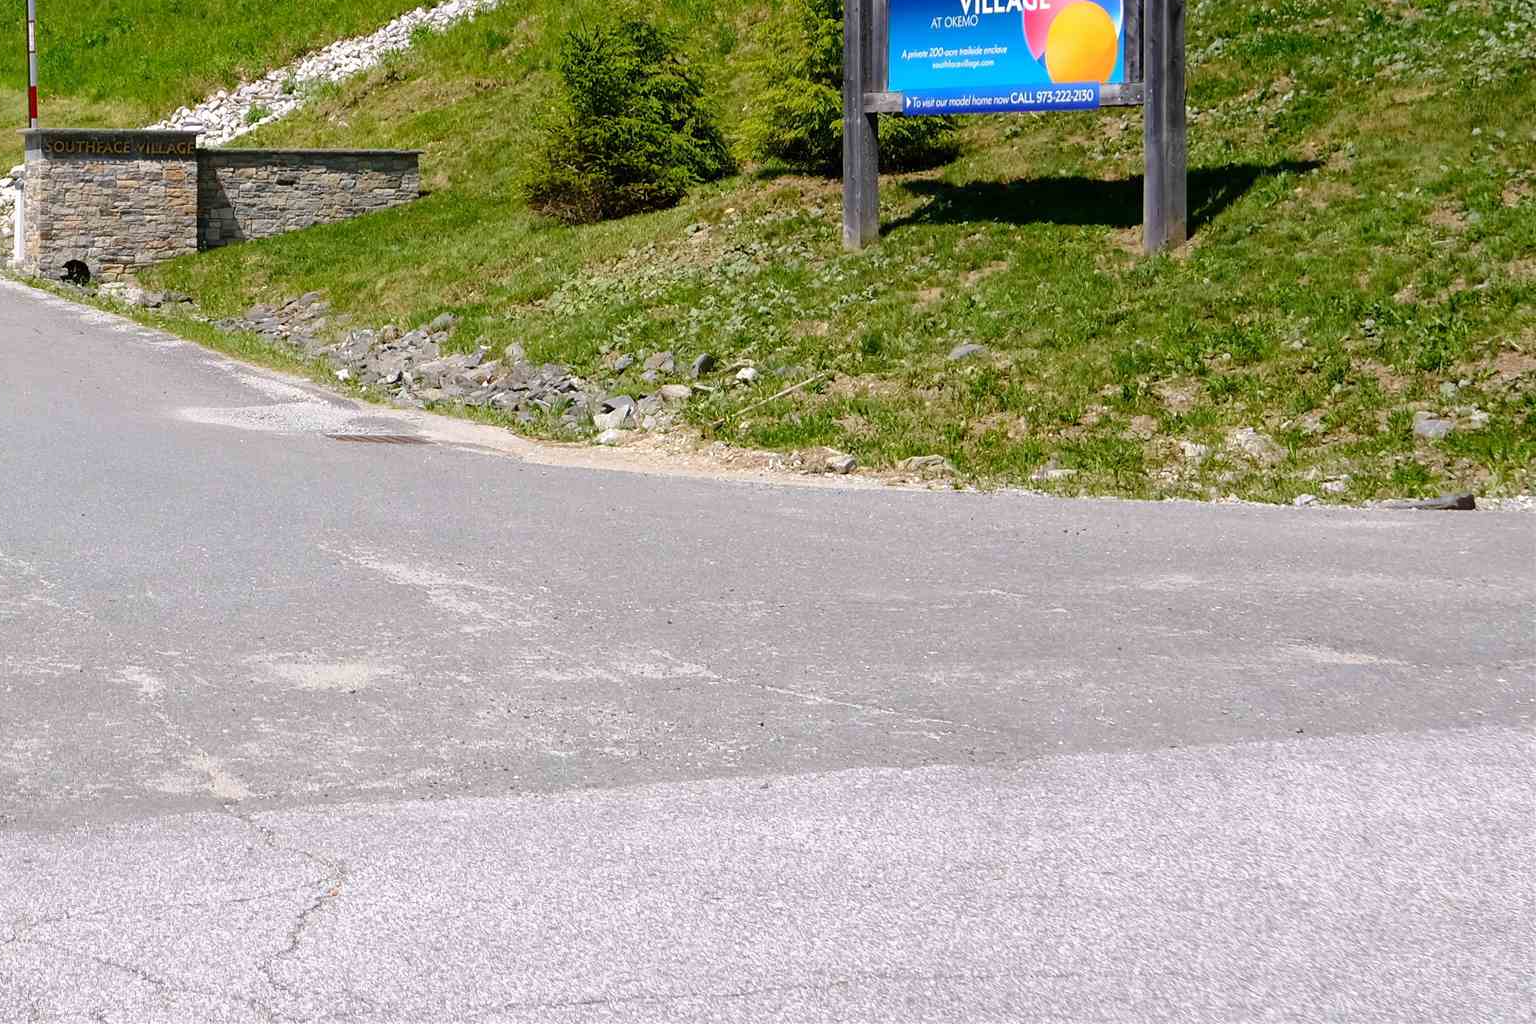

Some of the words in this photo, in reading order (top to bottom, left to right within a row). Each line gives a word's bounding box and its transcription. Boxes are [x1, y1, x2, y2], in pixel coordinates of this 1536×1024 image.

[930, 17, 943, 29] AT
[944, 14, 979, 28] OKEMO
[912, 96, 921, 108] To
[922, 98, 935, 107] visit
[935, 98, 948, 107] our
[948, 95, 971, 106] model
[971, 94, 992, 105] home
[993, 97, 1010, 105] now
[1010, 91, 1035, 104] CALL
[1036, 89, 1094, 103] 973-222-2130
[45, 140, 131, 154] SOUTHFACE
[135, 142, 196, 155] VILLAGE
